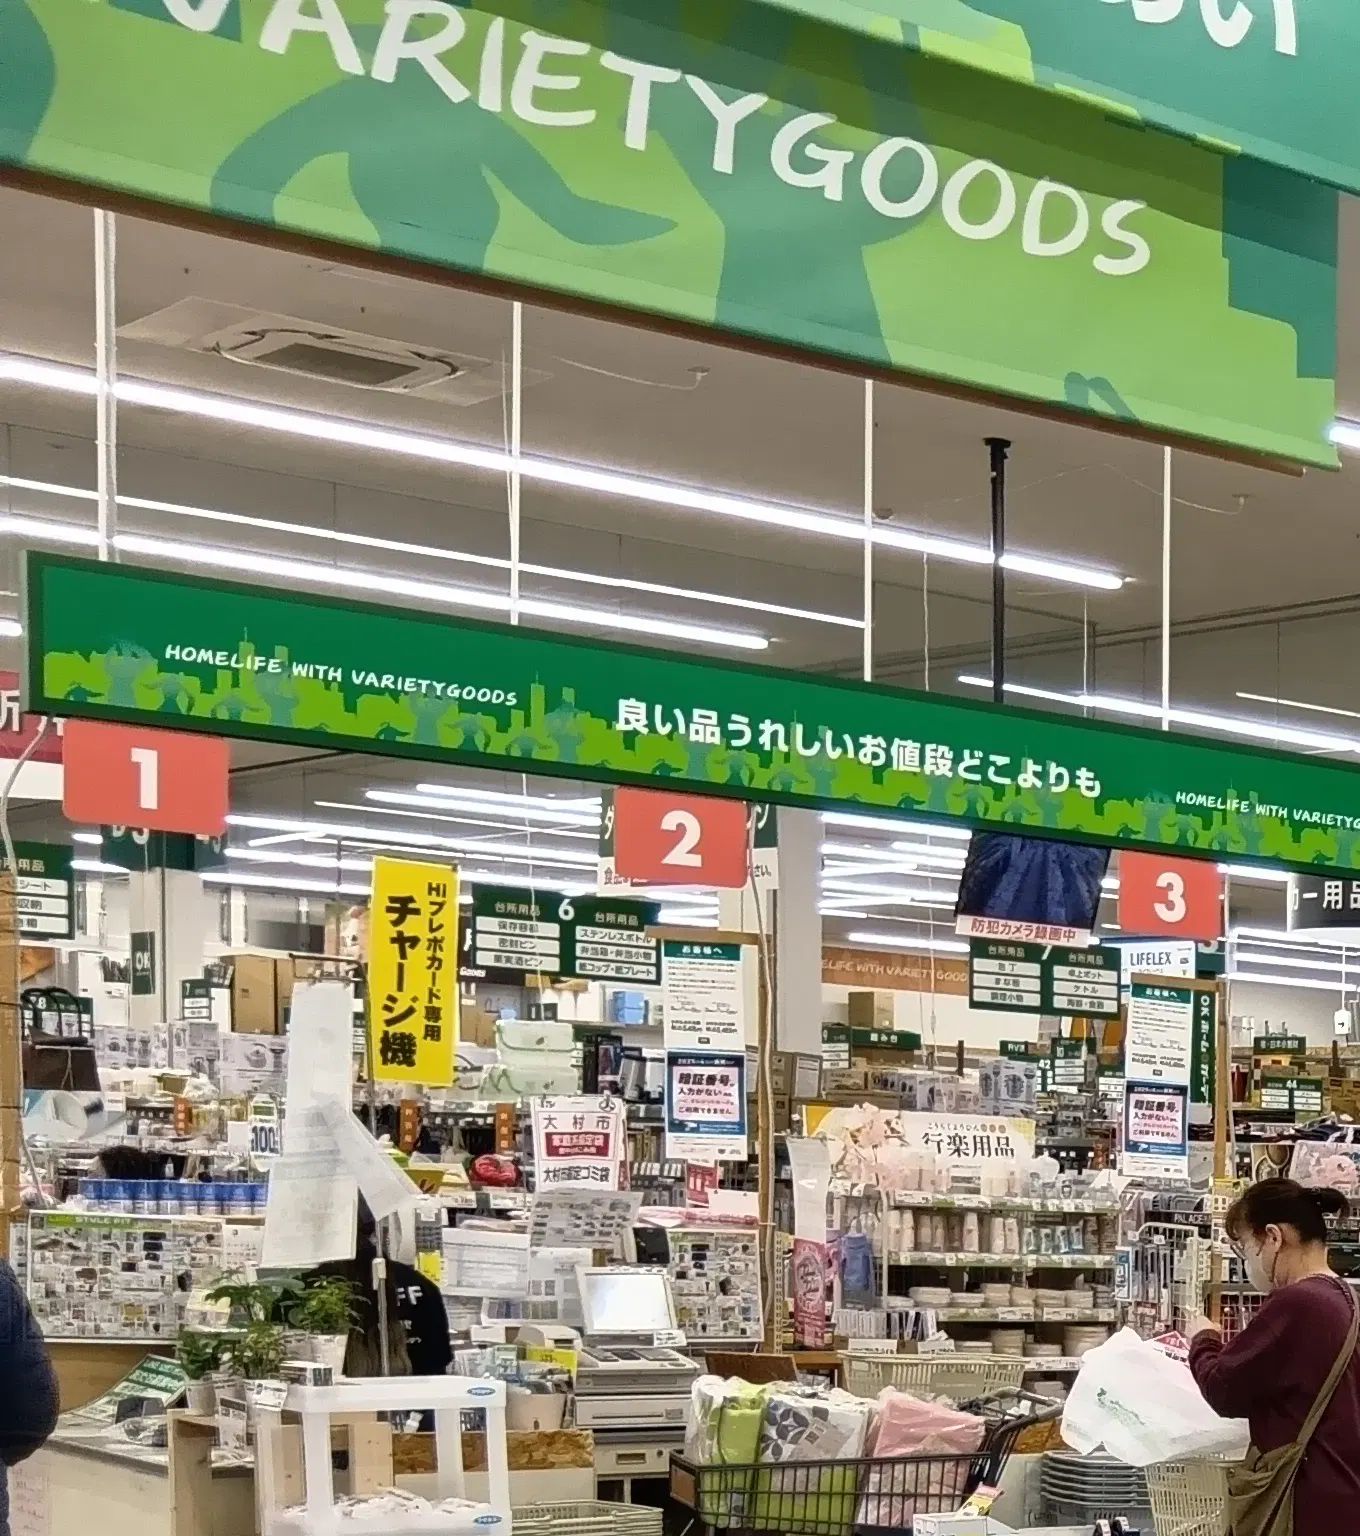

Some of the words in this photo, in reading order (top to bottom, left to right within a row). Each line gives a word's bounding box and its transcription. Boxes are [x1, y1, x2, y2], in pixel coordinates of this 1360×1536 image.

[164, 643, 283, 674] HOMELIFE
[292, 661, 343, 683] WITH
[350, 670, 519, 707] VARIETYGOODS
[615, 697, 1102, 799] 良い品うれしいお値段どこよりも
[130, 747, 159, 809] 1
[1175, 790, 1250, 815] HOMELIFE
[1255, 800, 1289, 820] WITH
[660, 809, 702, 868] 2
[557, 898, 576, 921] 6
[1153, 871, 1187, 923] 3
[970, 917, 1077, 943] 防犯カメラ録画中
[379, 894, 422, 1068] チャージ機
[1129, 951, 1173, 967] LIFELEX
[921, 1132, 1015, 1158] 行楽用品
